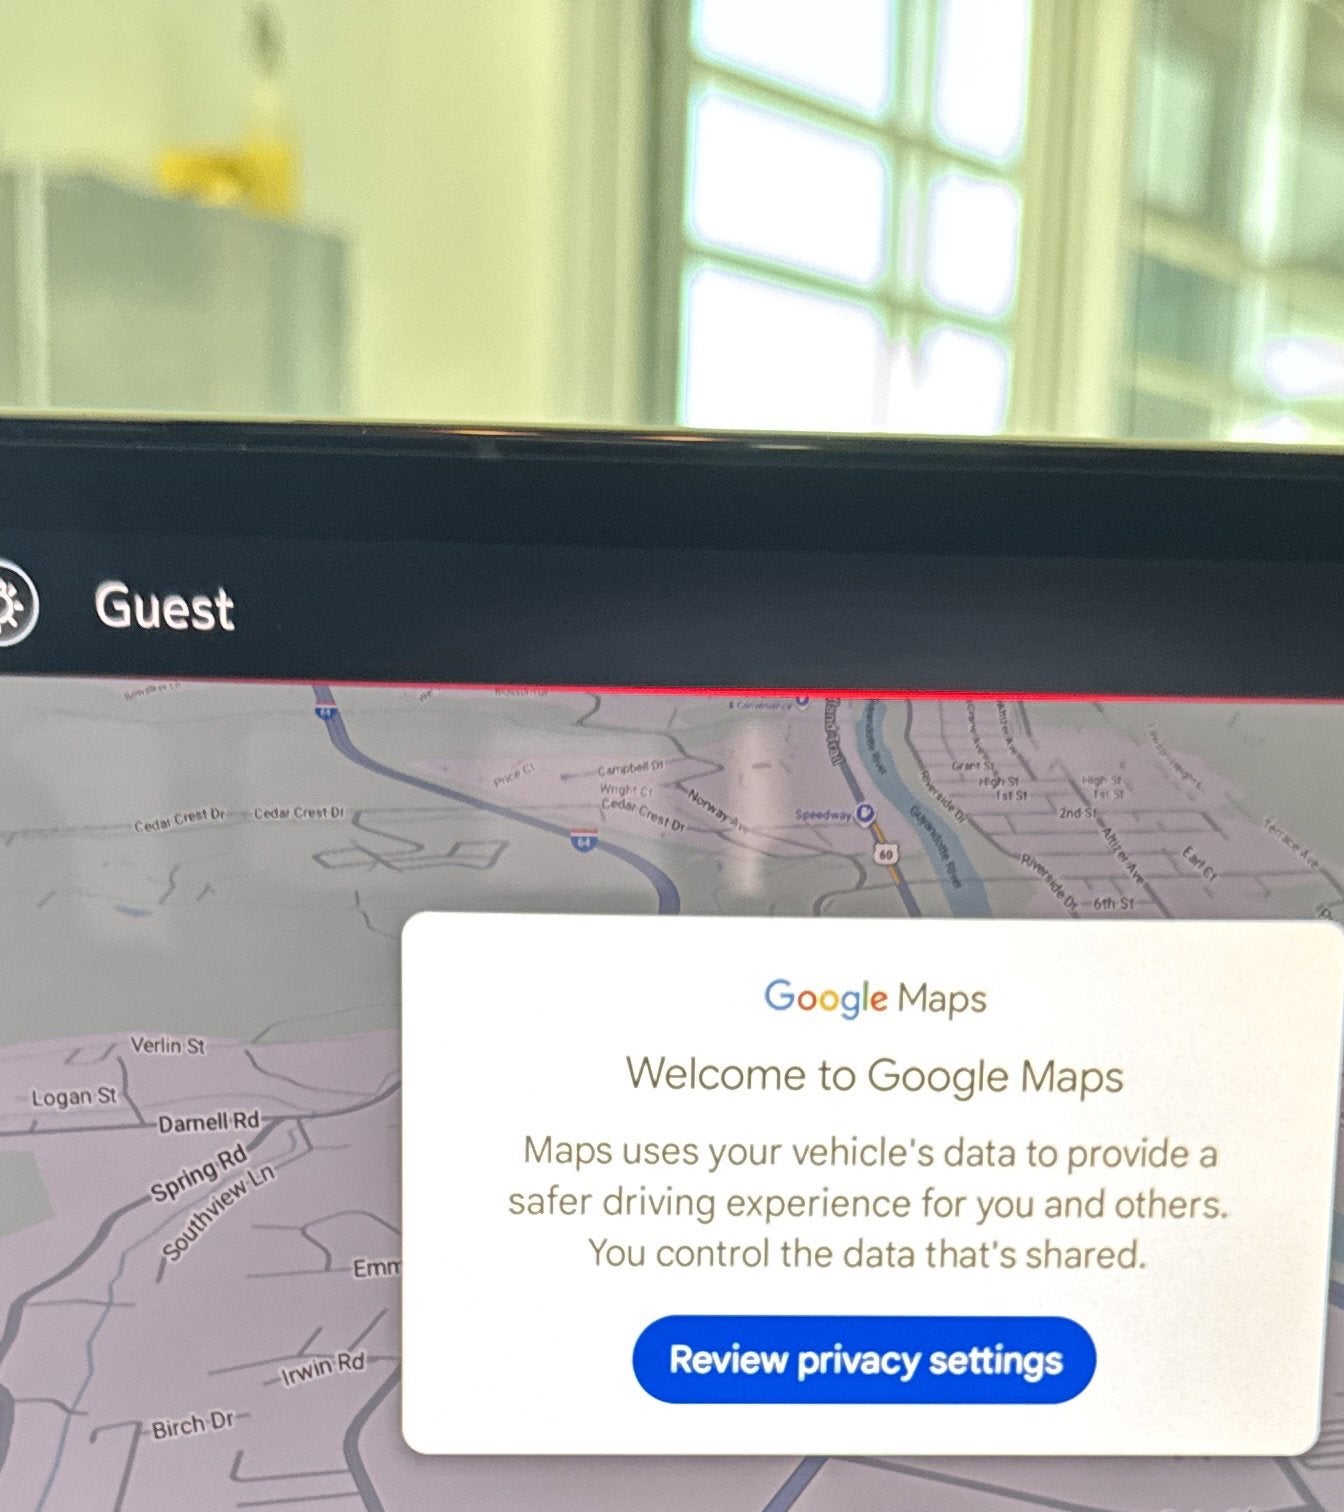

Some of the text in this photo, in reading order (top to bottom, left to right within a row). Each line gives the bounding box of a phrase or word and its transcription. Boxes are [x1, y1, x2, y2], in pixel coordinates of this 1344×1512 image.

[95, 580, 235, 632] Guest
[597, 761, 650, 778] Campbell
[1007, 776, 1020, 787] St
[599, 783, 638, 799] Wright
[687, 787, 730, 823] Norway
[1016, 790, 1028, 801] St
[173, 808, 208, 825] Crest
[210, 807, 227, 821] Dr
[293, 807, 328, 819] Crest
[601, 798, 686, 832] Cedar Crest Dr
[795, 809, 852, 823] Speedway
[1059, 807, 1098, 819] 2nd St
[879, 849, 893, 860] 60
[1102, 827, 1145, 886] Altizer Ave
[1019, 852, 1079, 911] Riverside Dr
[1093, 898, 1135, 910] 6th St
[764, 978, 988, 1022] Google Maps
[130, 1036, 205, 1055] Verlin St
[626, 1055, 1125, 1103] Welcome to Google Maps
[32, 1087, 117, 1111] Logan St
[158, 1110, 261, 1134] Darnell Rd
[524, 1135, 1218, 1175] Maps uses your vehicle's data to provide a
[150, 1144, 249, 1204] Spring Rd
[162, 1163, 277, 1263] Southview Ln
[508, 1185, 1229, 1226] safer driving experience for you and others.
[587, 1238, 1147, 1271] You control the data that's shared.
[281, 1351, 366, 1388] Irwin Rd
[669, 1343, 1064, 1385] Review privacy settings
[151, 1410, 235, 1440] Birch Dr
